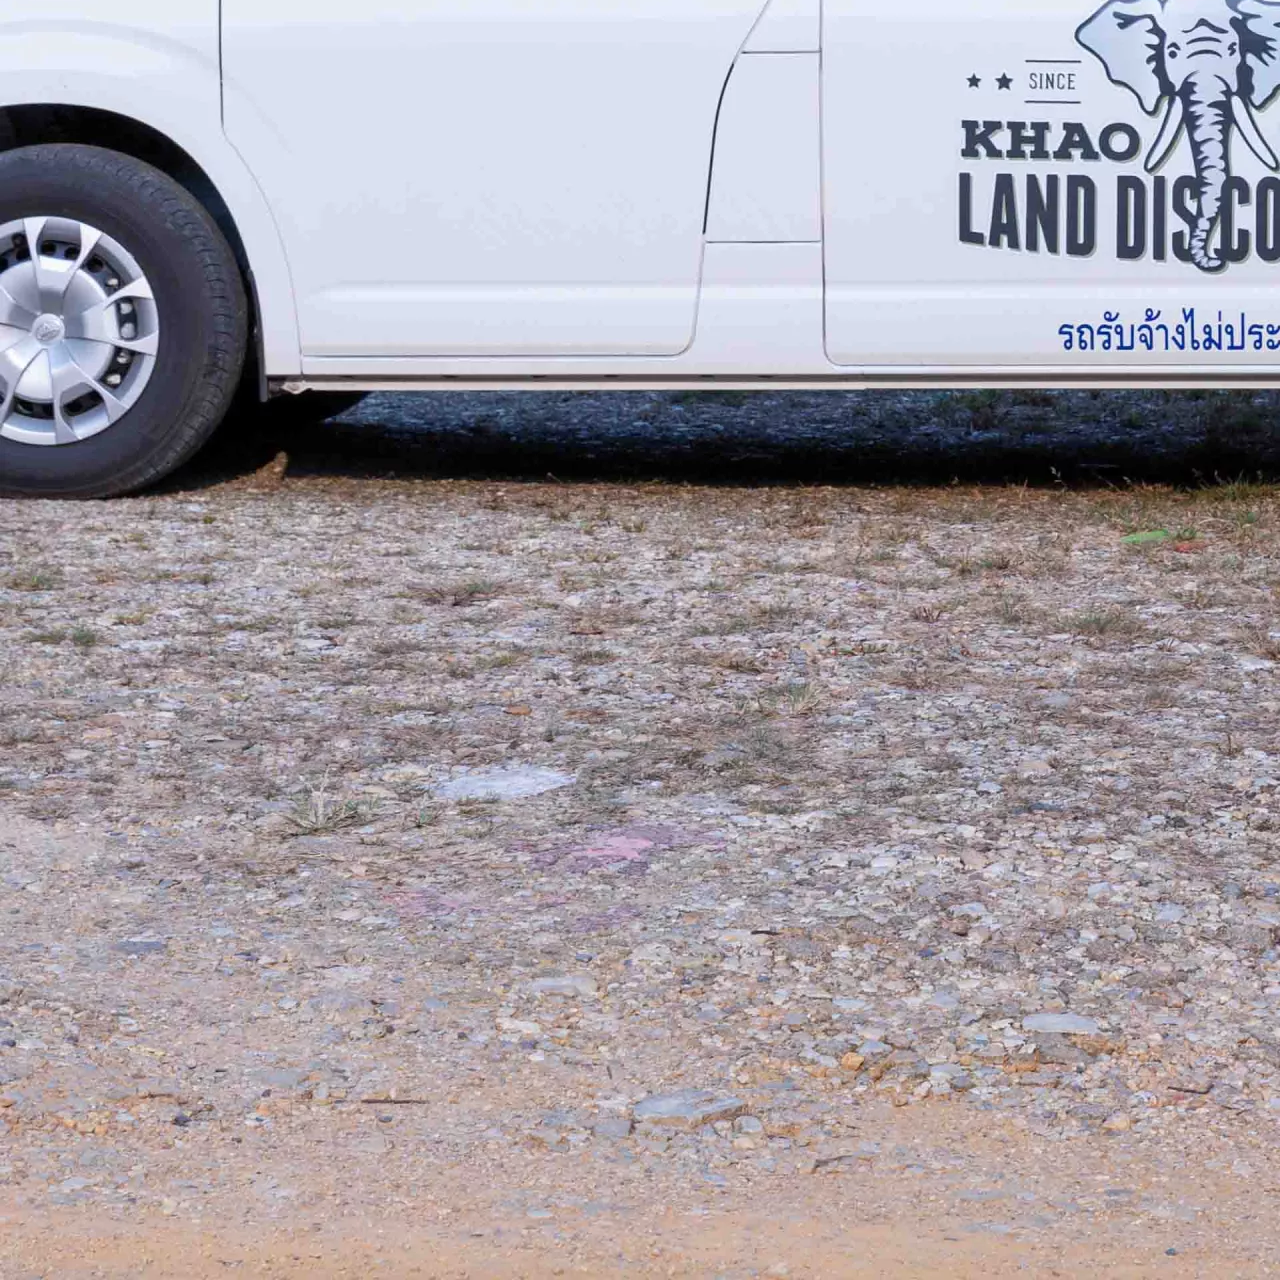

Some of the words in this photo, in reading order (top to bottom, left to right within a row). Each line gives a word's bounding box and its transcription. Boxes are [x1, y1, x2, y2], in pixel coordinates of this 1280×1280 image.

[1028, 72, 1076, 90] SINCE
[960, 119, 1142, 163] KHAO
[958, 172, 1099, 258] LAND
